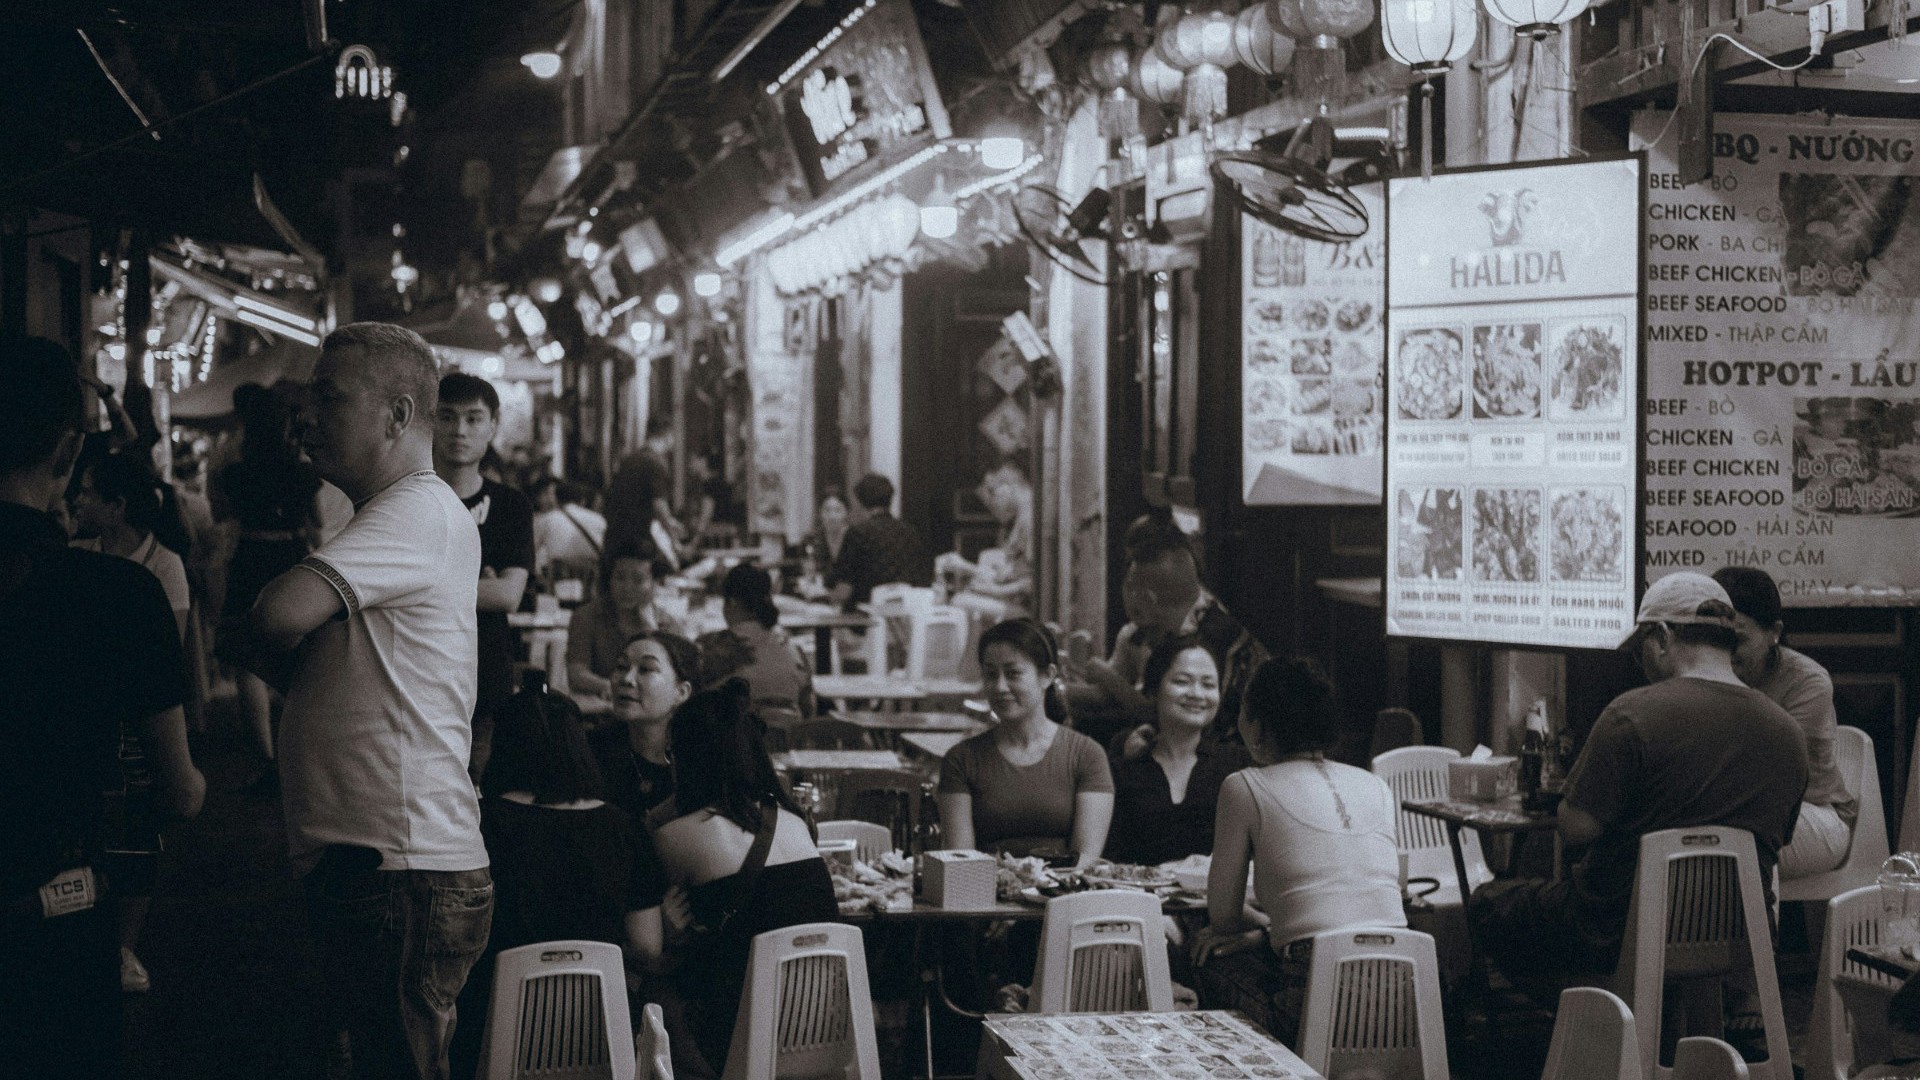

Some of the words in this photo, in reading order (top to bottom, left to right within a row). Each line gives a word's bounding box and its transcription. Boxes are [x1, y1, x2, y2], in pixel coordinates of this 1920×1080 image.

[1788, 130, 1915, 163] NƯỚNG
[1649, 173, 1686, 190] BEE
[1711, 171, 1738, 191] BÒ
[1649, 204, 1736, 221] CHICKEN
[1649, 234, 1700, 251] PORK
[1720, 236, 1744, 252] BA
[1449, 250, 1568, 289] HALIDA
[1648, 265, 1690, 281] BEEF
[1695, 265, 1782, 283] CHICKEN
[1648, 296, 1690, 312] BEEF
[1695, 295, 1787, 313] SEAFOOD
[1648, 326, 1708, 342] MIXED
[1683, 360, 1822, 386] HOTPOT
[1850, 348, 1918, 387] LẨU
[1647, 399, 1688, 415] BEEF
[1708, 394, 1735, 416] BÒ
[1647, 429, 1733, 446] CHICKEN
[1753, 425, 1784, 445] GÀ
[1647, 460, 1687, 476] BEEF
[1694, 460, 1780, 476] CHICKEN
[1798, 455, 1828, 478] BÒ
[1646, 490, 1687, 507] BEEF
[1694, 490, 1784, 507] SEAFOOD
[1645, 520, 1737, 536] SEAFOOD
[1646, 550, 1704, 566] MIXED
[50, 879, 84, 896] TCS
